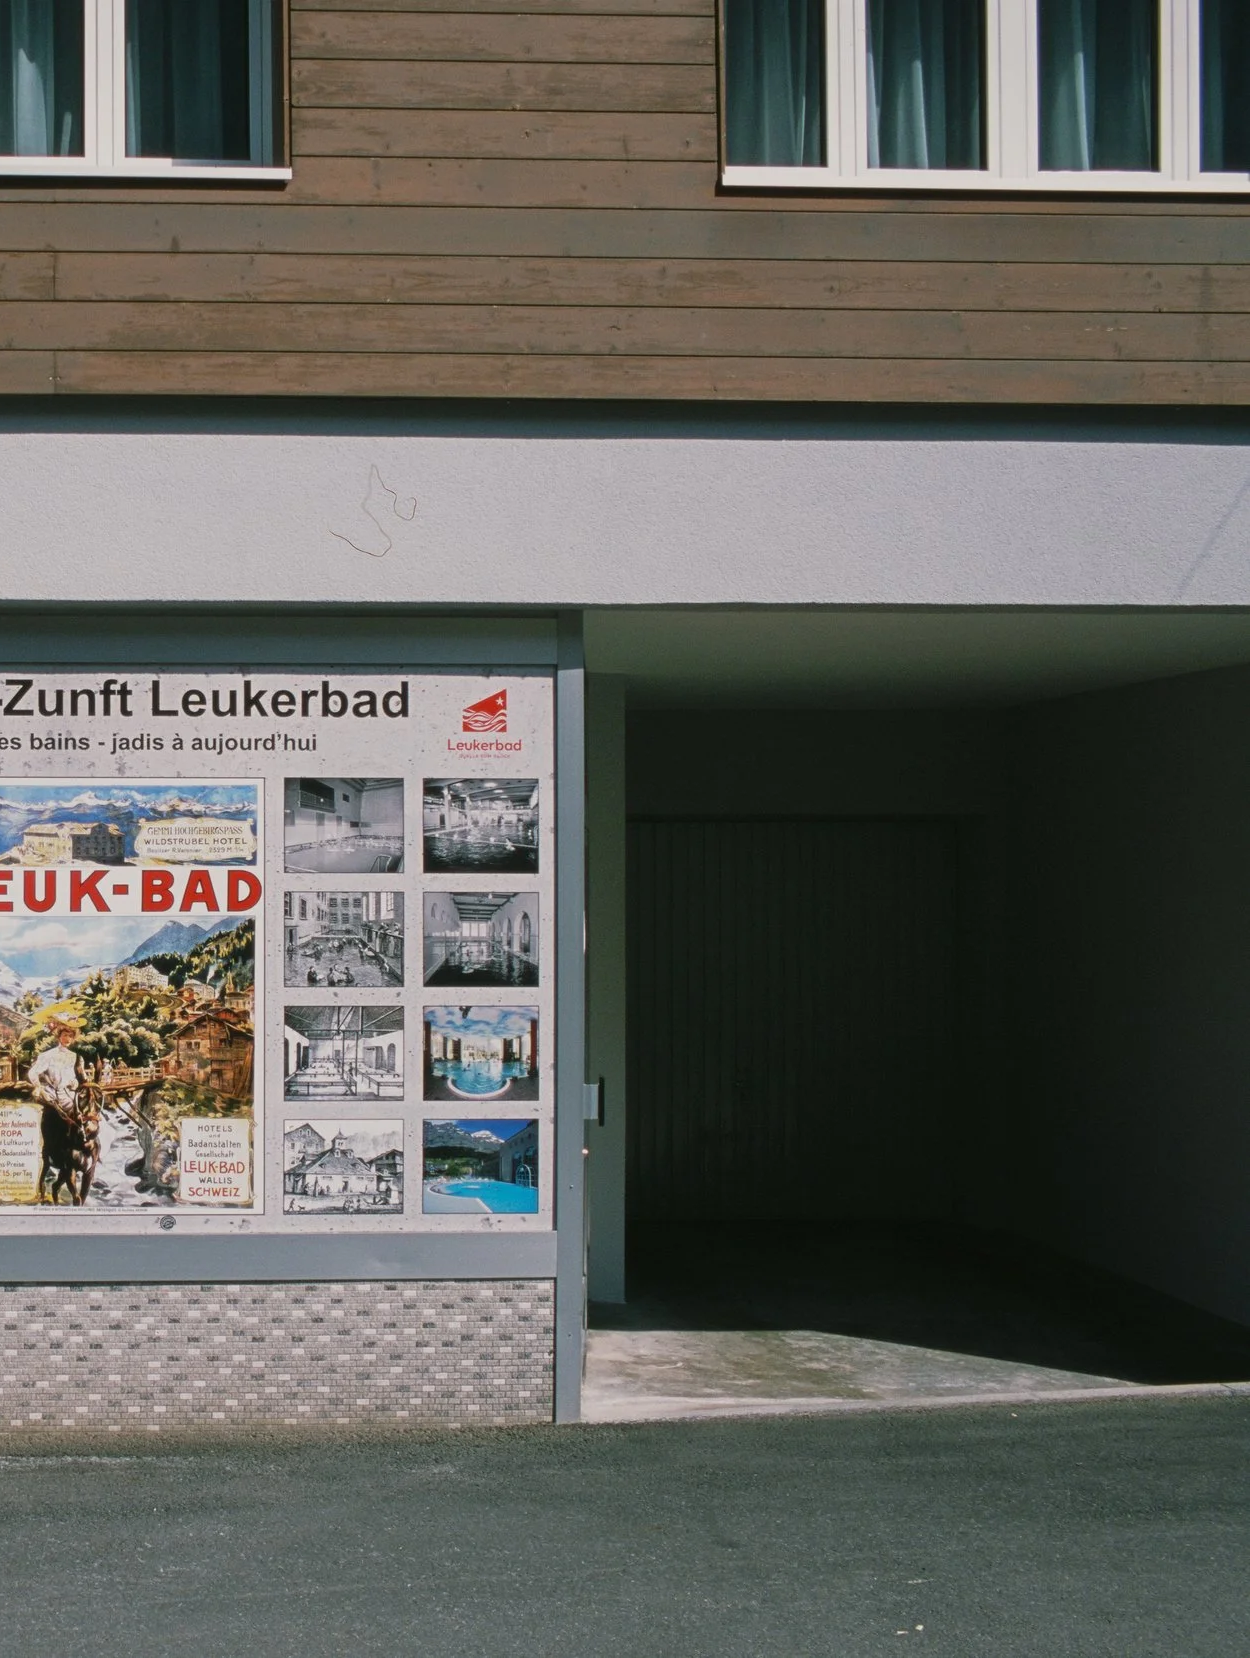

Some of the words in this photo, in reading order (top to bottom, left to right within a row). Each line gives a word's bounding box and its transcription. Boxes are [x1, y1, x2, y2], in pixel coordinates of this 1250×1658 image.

[151, 680, 410, 718] Leukerbad
[30, 733, 90, 751] bains
[111, 733, 165, 756] jadis
[171, 733, 184, 752] à
[191, 733, 317, 756] aujourd’hui
[447, 739, 522, 751] Leukerbad
[147, 826, 172, 835] GEMMI
[175, 826, 243, 834] HOCHGEBIRGSPASS
[189, 1139, 241, 1148] Badanstalten
[184, 1161, 245, 1174] LEUK-BAD
[23, 1170, 33, 1178] Tag
